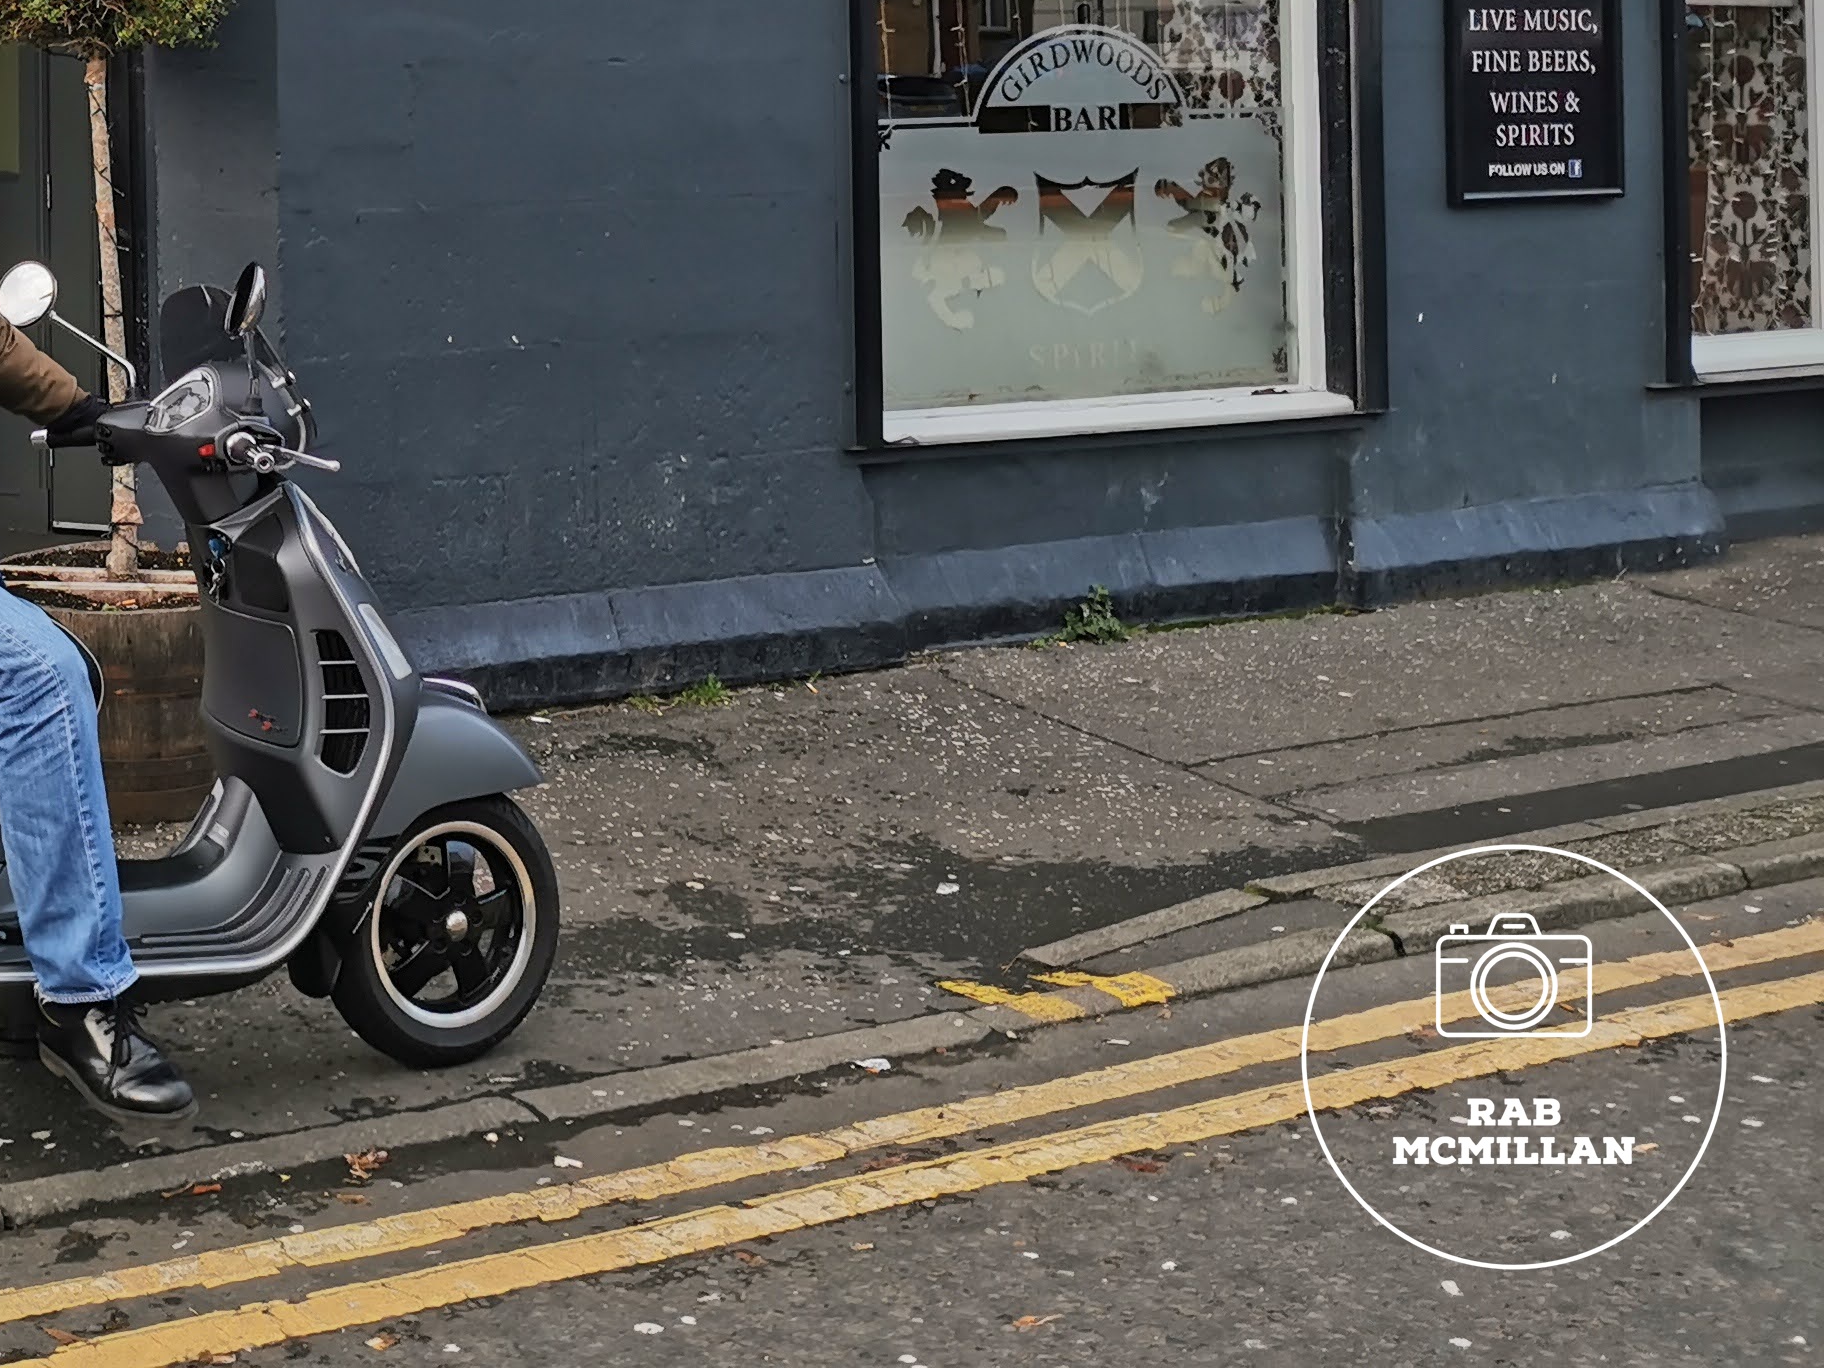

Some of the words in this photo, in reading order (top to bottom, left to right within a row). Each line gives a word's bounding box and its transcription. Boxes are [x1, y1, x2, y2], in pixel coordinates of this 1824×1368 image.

[1468, 8, 1517, 31] LIVE
[1523, 8, 1598, 34] MUSIC,
[1000, 37, 1167, 102] GIRDWOODS
[1471, 50, 1521, 73] FINE
[1527, 49, 1596, 75] BEERS,
[1489, 91, 1559, 113] WINES
[1564, 90, 1580, 113] &
[1053, 105, 1119, 132] BAR
[1495, 123, 1575, 147] SPIRITS
[1488, 163, 1532, 177] FOLLOW
[1533, 163, 1548, 176] US
[1549, 162, 1565, 176] ON
